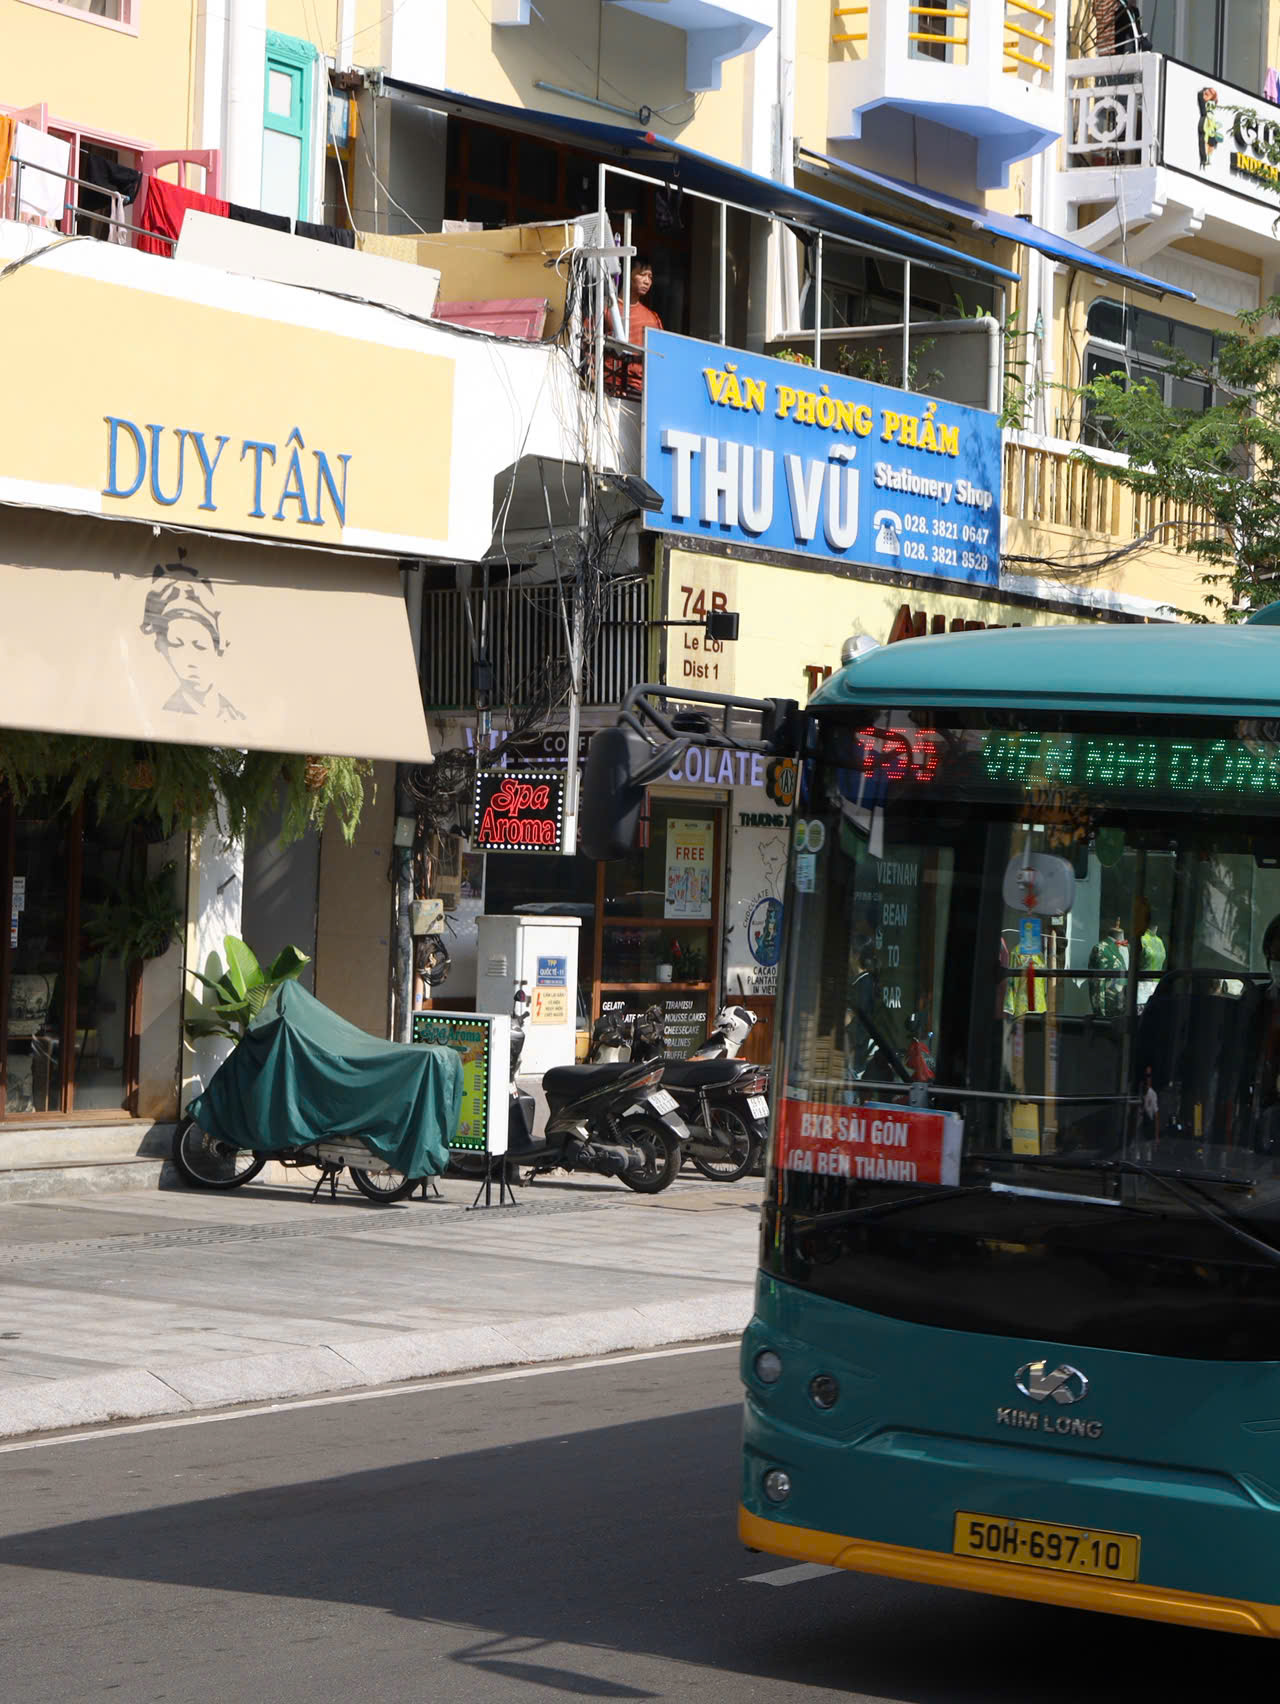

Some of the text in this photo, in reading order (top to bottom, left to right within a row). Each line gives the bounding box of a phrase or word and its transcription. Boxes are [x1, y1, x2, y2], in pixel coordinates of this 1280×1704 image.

[703, 362, 961, 458] VĂN PHÒNG PHẨM
[101, 415, 353, 529] DUY TÂN
[873, 461, 994, 513] Stationery Shop
[660, 428, 861, 554] THU VŨ
[903, 513, 990, 546] 028. 3821 0647
[903, 540, 989, 573] 028. 3821 8528
[683, 632, 699, 650] Le
[683, 659, 719, 680] Dist 1
[1086, 739, 1158, 788] NHI
[490, 778, 550, 817] Spa
[478, 806, 557, 846] Aroma
[675, 846, 705, 862] FREE
[876, 861, 919, 887] VIETNAM
[882, 903, 909, 927] BEAN
[753, 966, 777, 976] CACAO
[887, 945, 901, 968] TO
[665, 1000, 694, 1010] TIRAMISU
[882, 986, 902, 1009] BAR
[663, 1025, 700, 1035] CHEESECAKE
[664, 1012, 707, 1022] MOUSSE CAKES
[448, 1025, 482, 1042] Aroma
[800, 1112, 910, 1147] BXB SÀI GÒN
[817, 1146, 850, 1178] BẾN
[995, 1406, 1104, 1440] KIM LONG
[968, 1520, 1121, 1571] 50H-697.10
